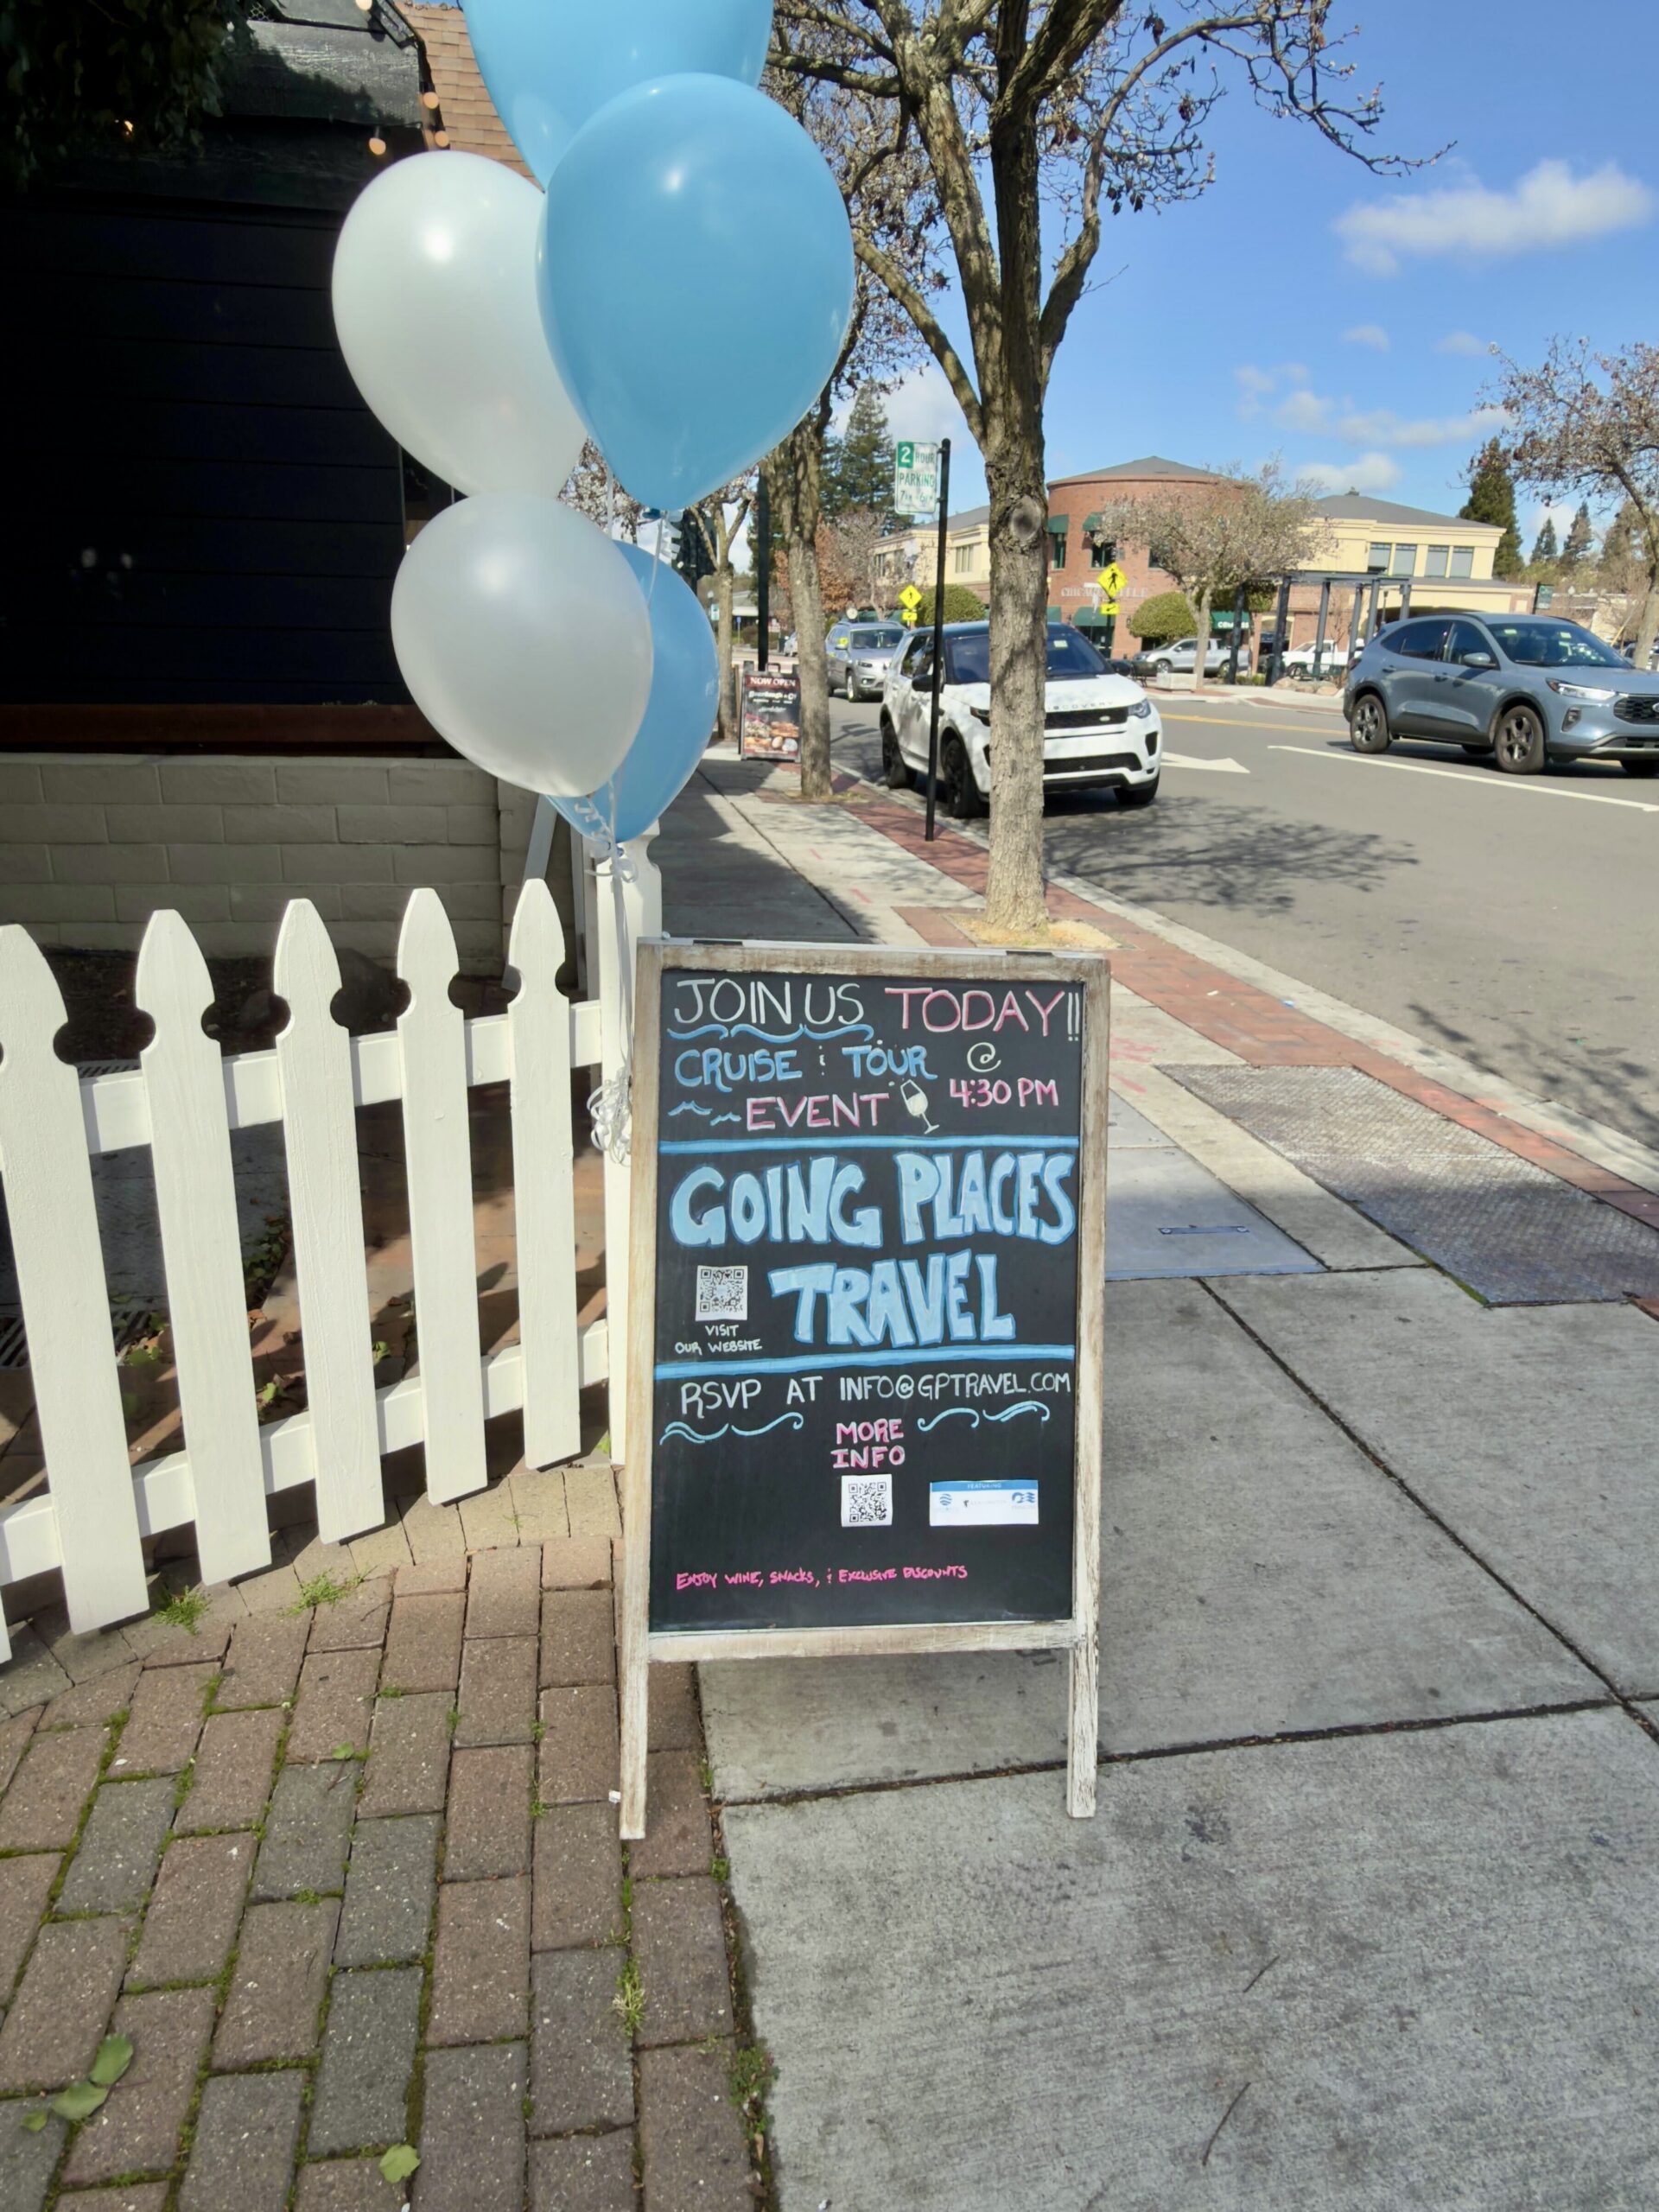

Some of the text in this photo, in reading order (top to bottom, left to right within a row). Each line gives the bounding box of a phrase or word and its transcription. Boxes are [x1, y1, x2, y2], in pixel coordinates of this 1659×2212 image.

[900, 446, 936, 463] 2 HOUR
[899, 472, 935, 487] PARKING
[750, 677, 796, 686] NOW OPEN
[674, 978, 1080, 1042] JOIN US TODAY!!
[674, 1047, 803, 1093] CRUISE
[842, 1044, 938, 1080] TOUR
[966, 1041, 1001, 1073] @
[949, 1077, 1059, 1109] 4:30 PM
[747, 1092, 890, 1132] EVENT
[670, 1149, 1077, 1250] GOING PLACES
[767, 1249, 1016, 1348] TRAVEL
[704, 1324, 740, 1338] VISIT
[674, 1338, 763, 1356] OUR WEBSITE
[680, 1372, 1071, 1420] RSVP AT INFO@GPTRAVEL.COM
[836, 1418, 905, 1445] MORE
[830, 1445, 906, 1469] INFO
[676, 1571, 718, 1591] ENJOY
[724, 1570, 764, 1588] WINE,
[838, 1567, 898, 1583] EXCLUSIVE
[902, 1565, 968, 1580] DISCOUNTS
